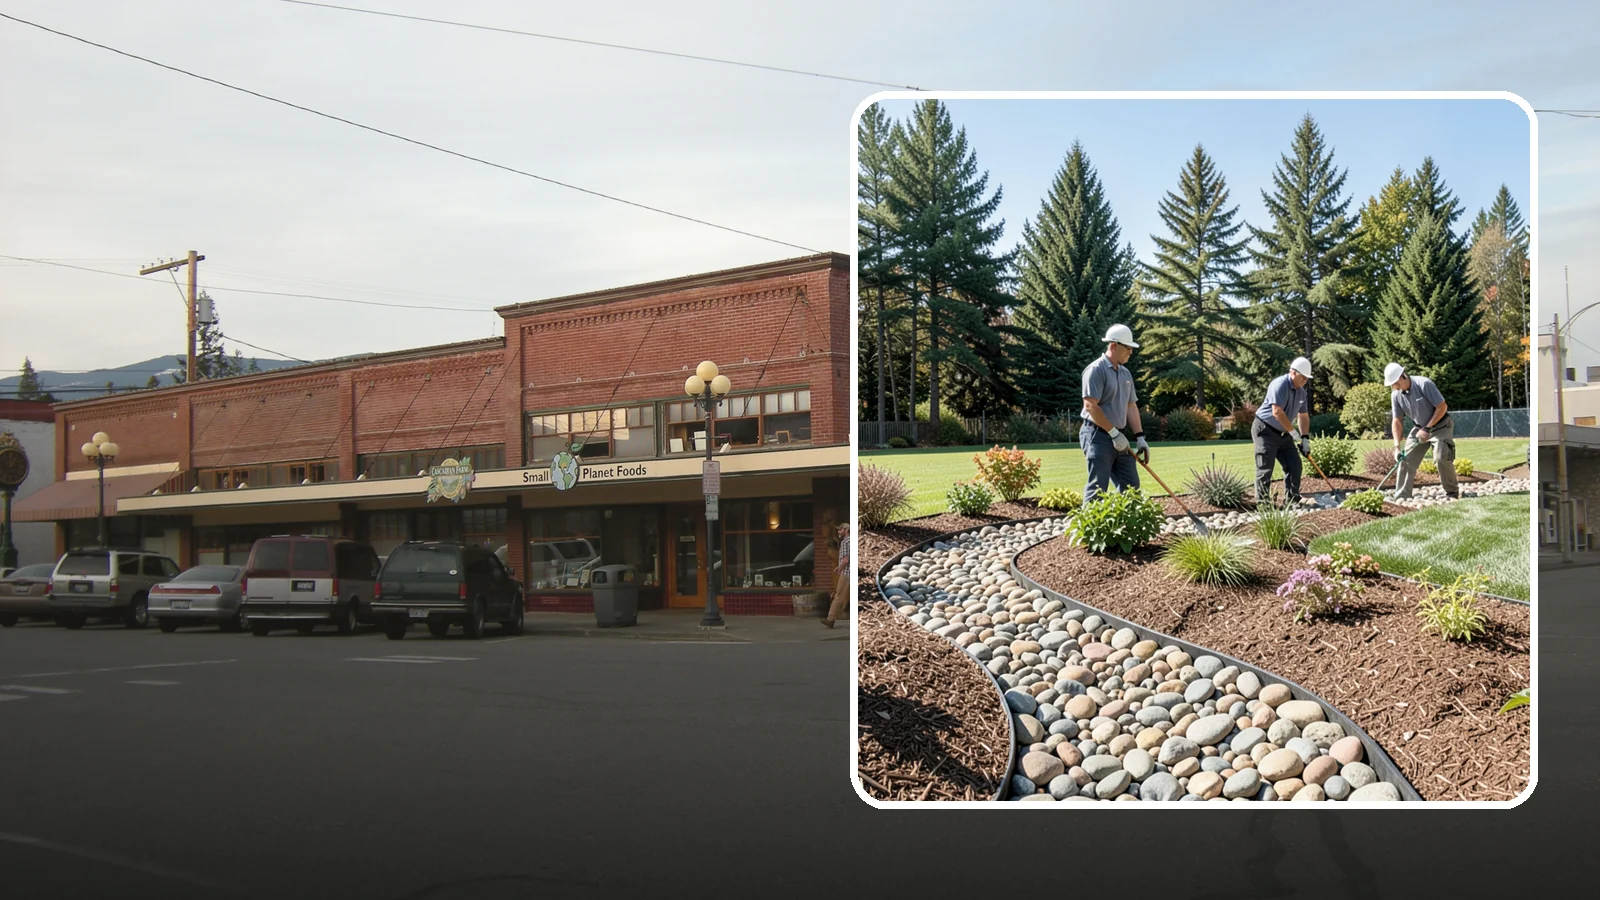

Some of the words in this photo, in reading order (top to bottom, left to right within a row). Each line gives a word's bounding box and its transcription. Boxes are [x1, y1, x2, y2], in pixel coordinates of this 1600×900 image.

[523, 471, 549, 483] Small
[583, 467, 614, 479] Planet
[617, 464, 647, 477] Foods
